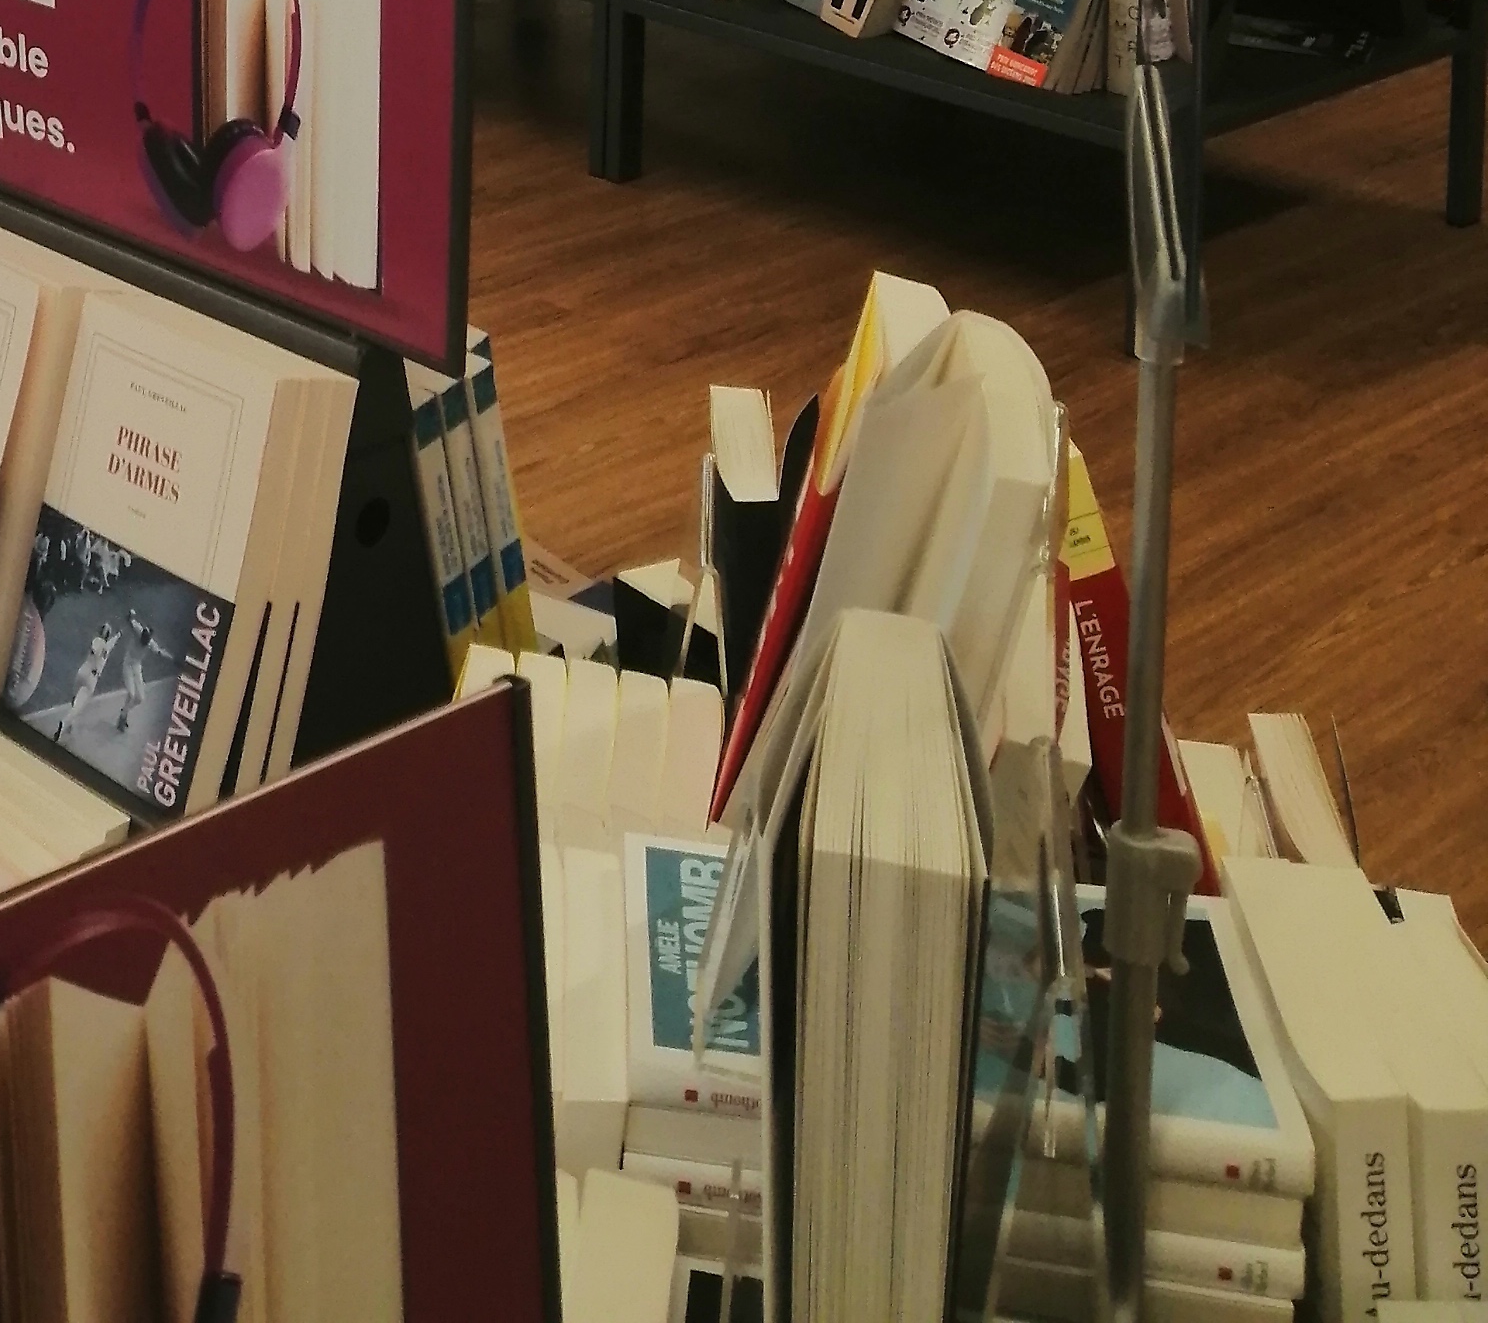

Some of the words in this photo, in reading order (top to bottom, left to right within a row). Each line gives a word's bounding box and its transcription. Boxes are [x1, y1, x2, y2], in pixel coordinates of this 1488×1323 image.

[117, 425, 182, 474] PHRASE
[107, 452, 180, 505] D'ARMES
[152, 601, 225, 808] GREVEILLAC
[136, 740, 163, 795] PAUL
